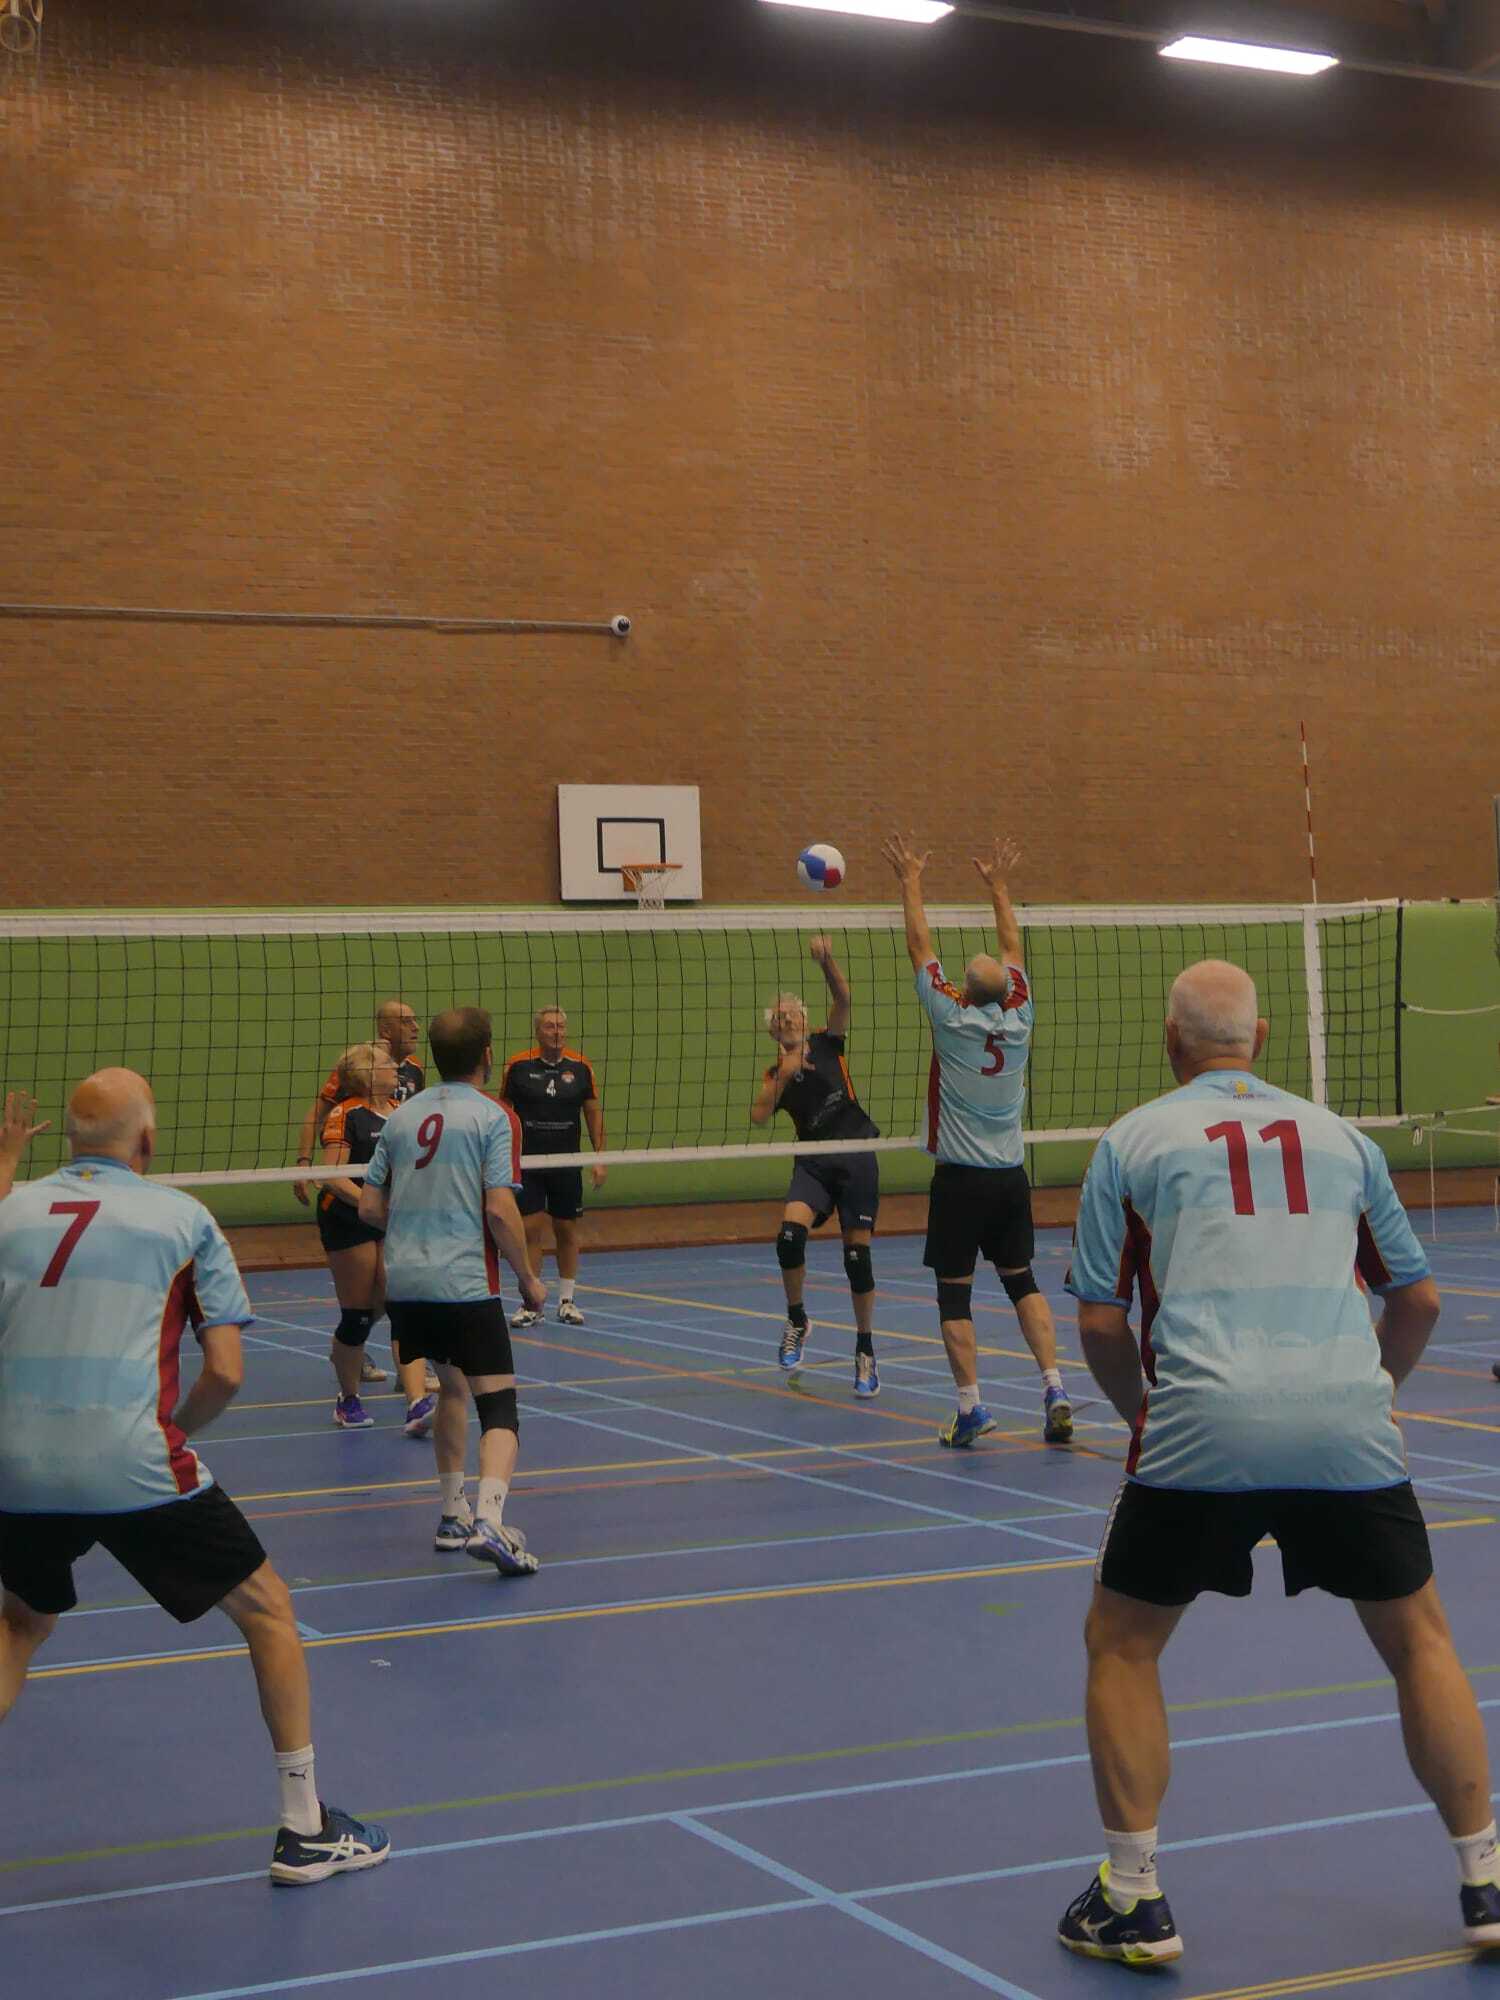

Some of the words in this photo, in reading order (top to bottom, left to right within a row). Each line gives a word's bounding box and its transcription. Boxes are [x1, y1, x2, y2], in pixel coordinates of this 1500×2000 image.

[981, 1029, 1009, 1076] 5
[546, 1078, 557, 1097] 4
[415, 1112, 444, 1170] 9
[1203, 1118, 1311, 1216] 11
[39, 1200, 102, 1288] 7
